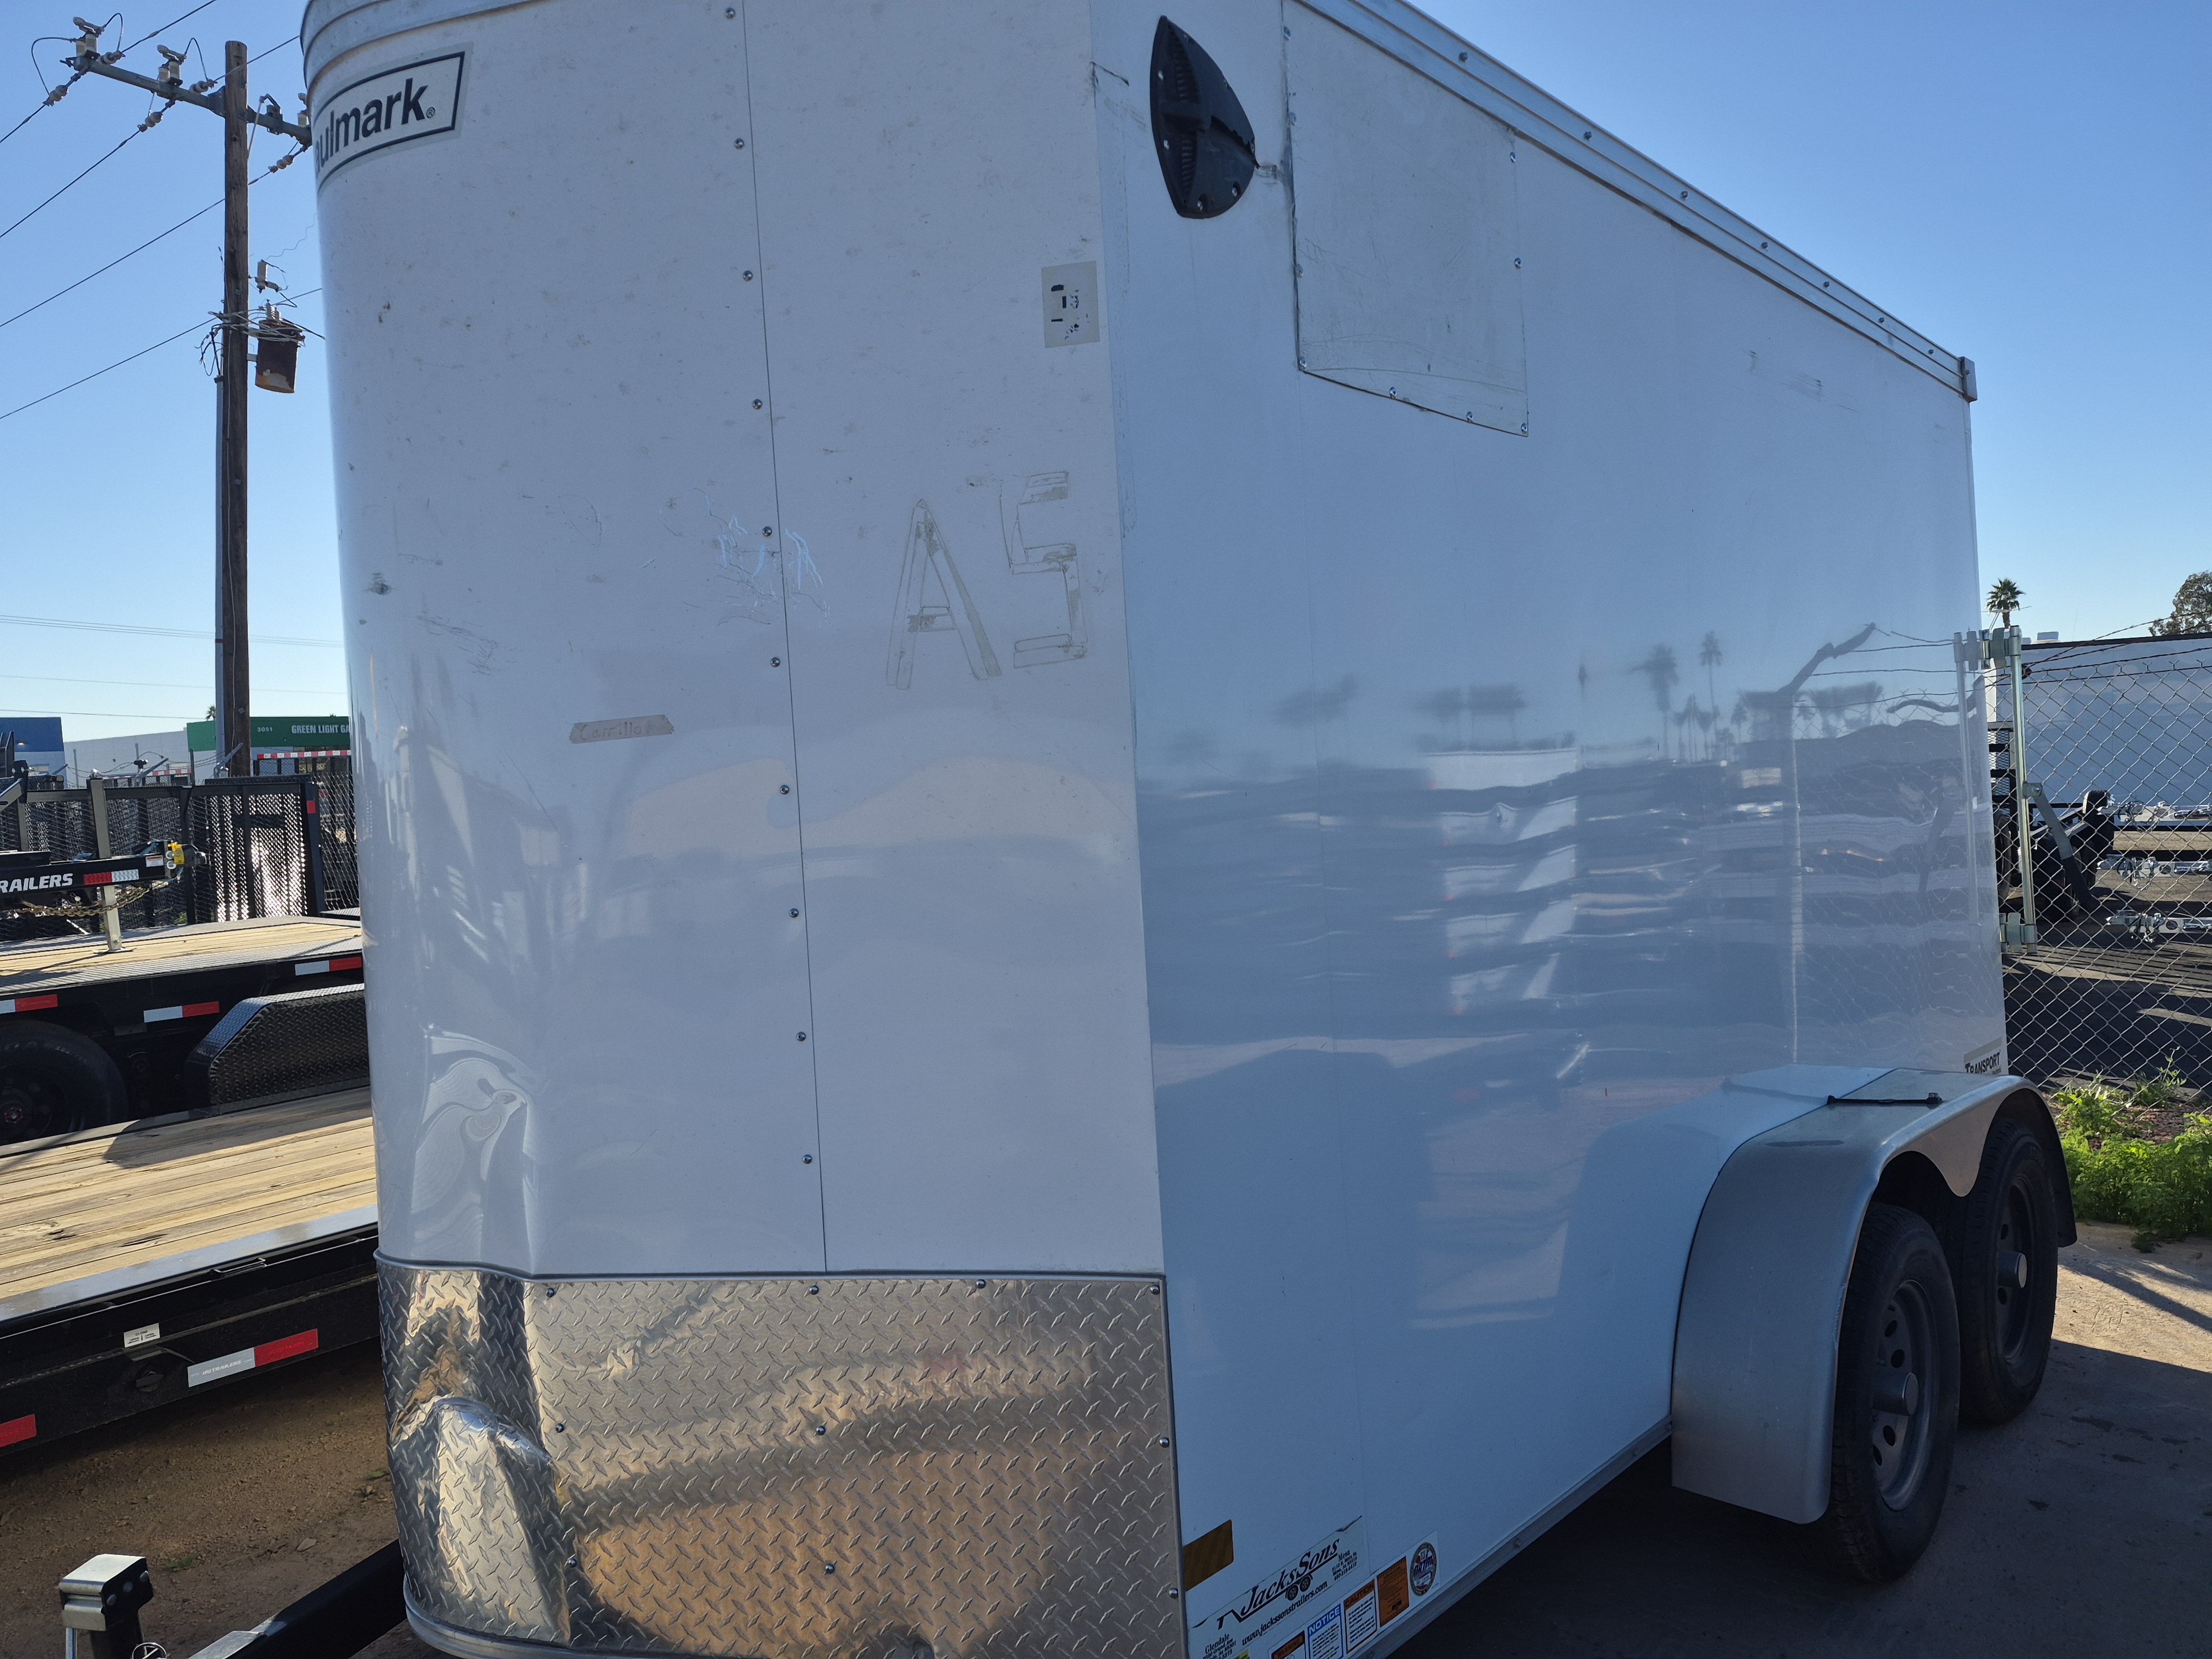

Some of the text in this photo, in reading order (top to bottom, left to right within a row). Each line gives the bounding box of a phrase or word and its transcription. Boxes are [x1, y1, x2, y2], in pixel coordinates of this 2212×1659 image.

[291, 725, 316, 734] GREEN
[318, 724, 339, 733] LIGHT
[1345, 1582, 1375, 1608] CAUTION
[1308, 1605, 1340, 1635] NOTICE
[1204, 1633, 1230, 1654] Glendale
